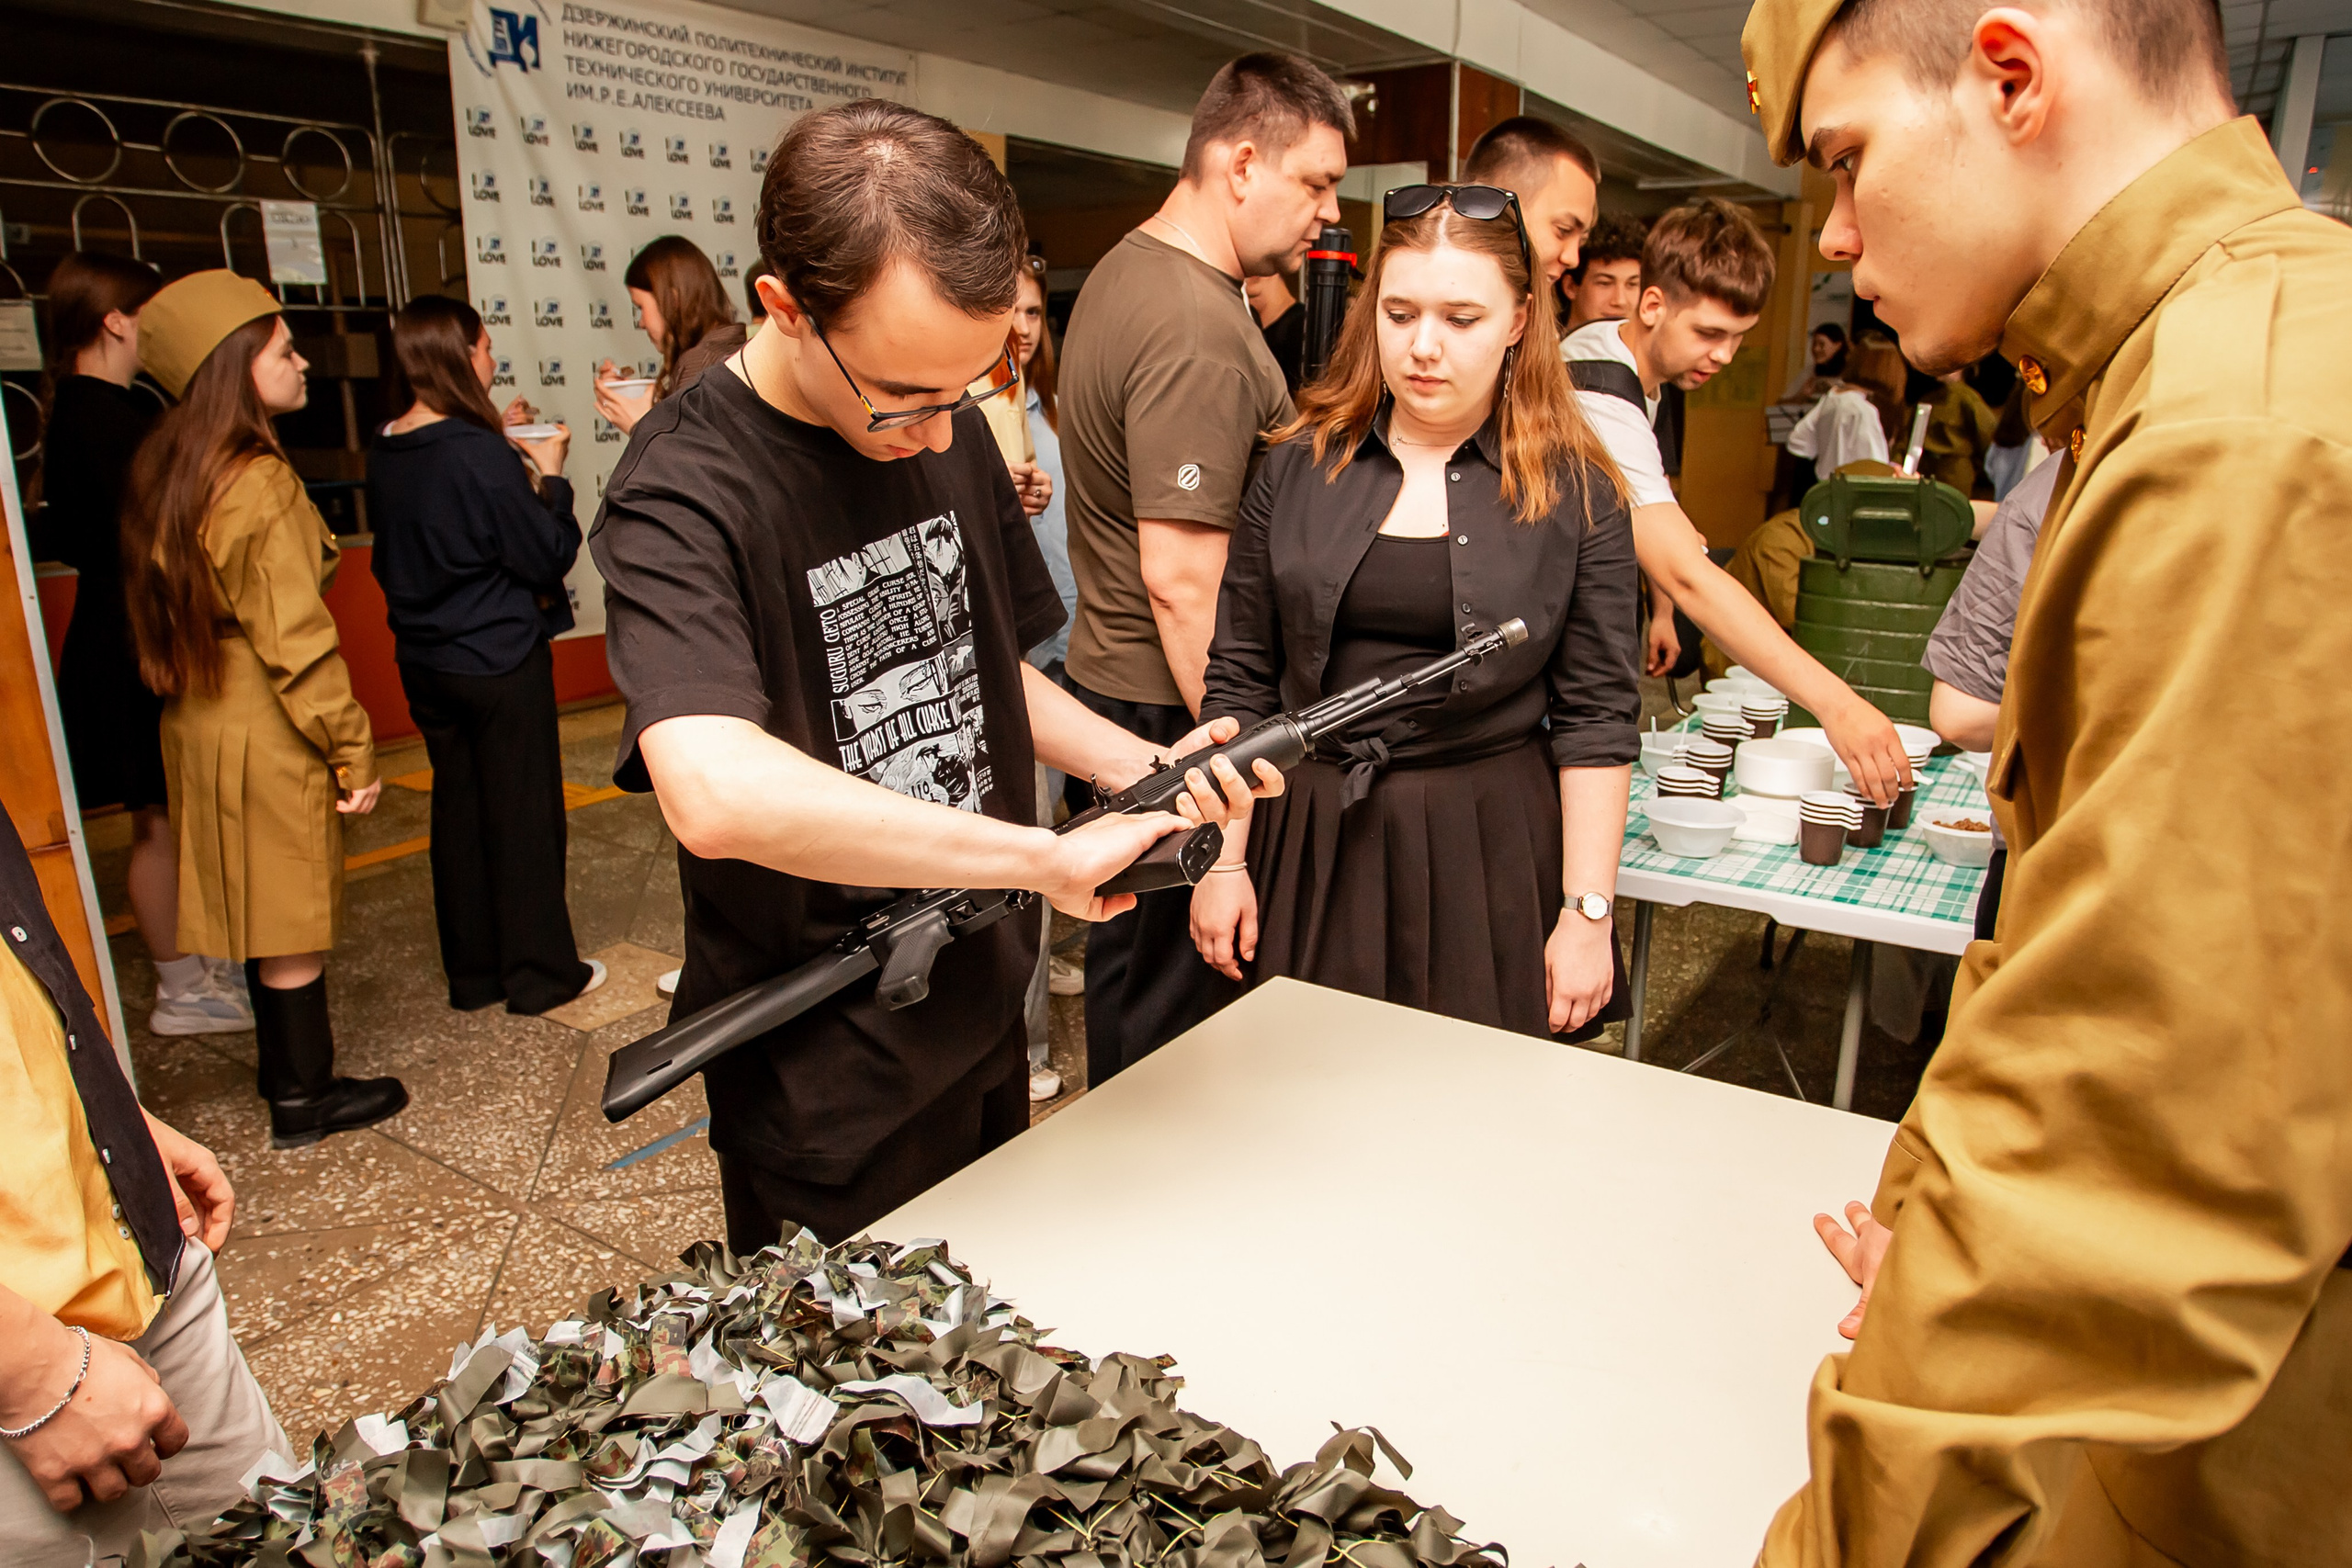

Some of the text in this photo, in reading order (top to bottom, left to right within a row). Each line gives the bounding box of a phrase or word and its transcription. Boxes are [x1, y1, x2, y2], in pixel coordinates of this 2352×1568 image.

[562, 3, 690, 44] ДЗЕРЖИНСКИЙ
[695, 31, 842, 73] ПОЛИТЕХНИЧЕСКИЙ
[563, 29, 724, 75] НИЖЕГОРОДСКОГО
[563, 54, 813, 109] ТЕХНИЧЕСКОГО УНИВЕРСИТЕТА
[468, 126, 497, 139] LOVE
[523, 133, 548, 146] LOVE
[573, 140, 598, 153] LOVE
[620, 146, 645, 159] LOVE
[666, 152, 690, 164] LOVE
[709, 158, 732, 170] LOVE
[473, 190, 500, 202] LOVE
[531, 194, 555, 208] LOVE
[578, 201, 605, 212] LOVE
[627, 205, 650, 217] LOVE
[671, 209, 693, 220] LOVE
[713, 213, 735, 225] LOVE
[478, 252, 506, 265] LOVE
[533, 255, 561, 267] LOVE
[583, 260, 605, 271] LOVE
[718, 267, 739, 278] LOVE
[481, 314, 512, 326] LOVE
[536, 316, 563, 327] LOVE
[590, 318, 613, 329] LOVE
[540, 375, 565, 387] LOVE
[595, 433, 620, 443] LOVE
[842, 595, 865, 610] SPECIAL
[882, 578, 905, 588] CURSE
[879, 586, 900, 598] ABILITY
[889, 615, 909, 625] ONCE
[842, 617, 865, 636] COMMANDS
[891, 623, 909, 632] HIGH
[843, 633, 859, 644] THEM
[820, 608, 850, 694] SUGURU GETO
[850, 668, 866, 680] CHOSE
[879, 651, 891, 662] PATH
[838, 741, 863, 773] THE
[885, 718, 899, 750] OF
[898, 711, 918, 742] ALL
[916, 701, 952, 735] CURSE
